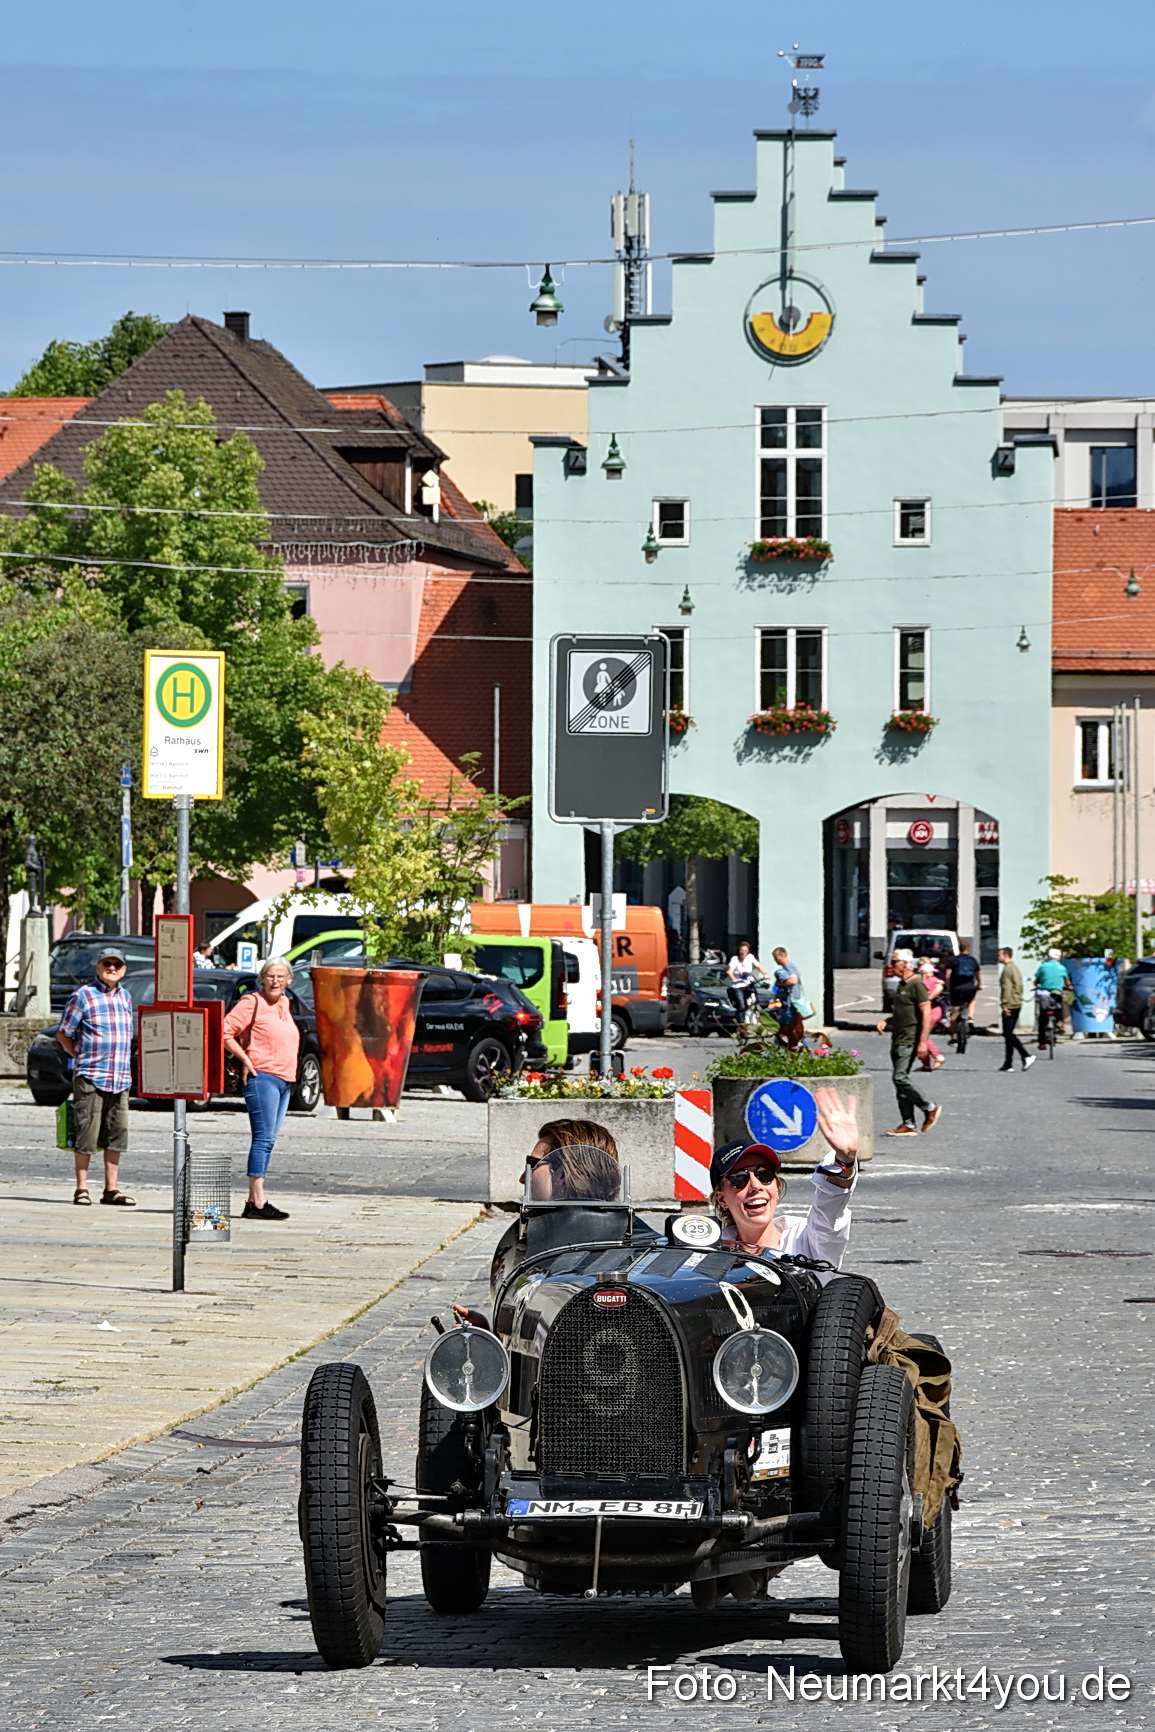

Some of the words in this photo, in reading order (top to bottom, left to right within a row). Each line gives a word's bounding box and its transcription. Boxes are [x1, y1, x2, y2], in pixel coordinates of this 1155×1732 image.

[172, 676, 195, 713] H
[589, 715, 630, 729] ZONE
[164, 735, 202, 746] Rathaus
[688, 1224, 705, 1234] 25
[596, 1295, 627, 1303] BUGATTI
[528, 1501, 575, 1514] NM
[599, 1501, 643, 1512] EB
[653, 1502, 698, 1516] 8H
